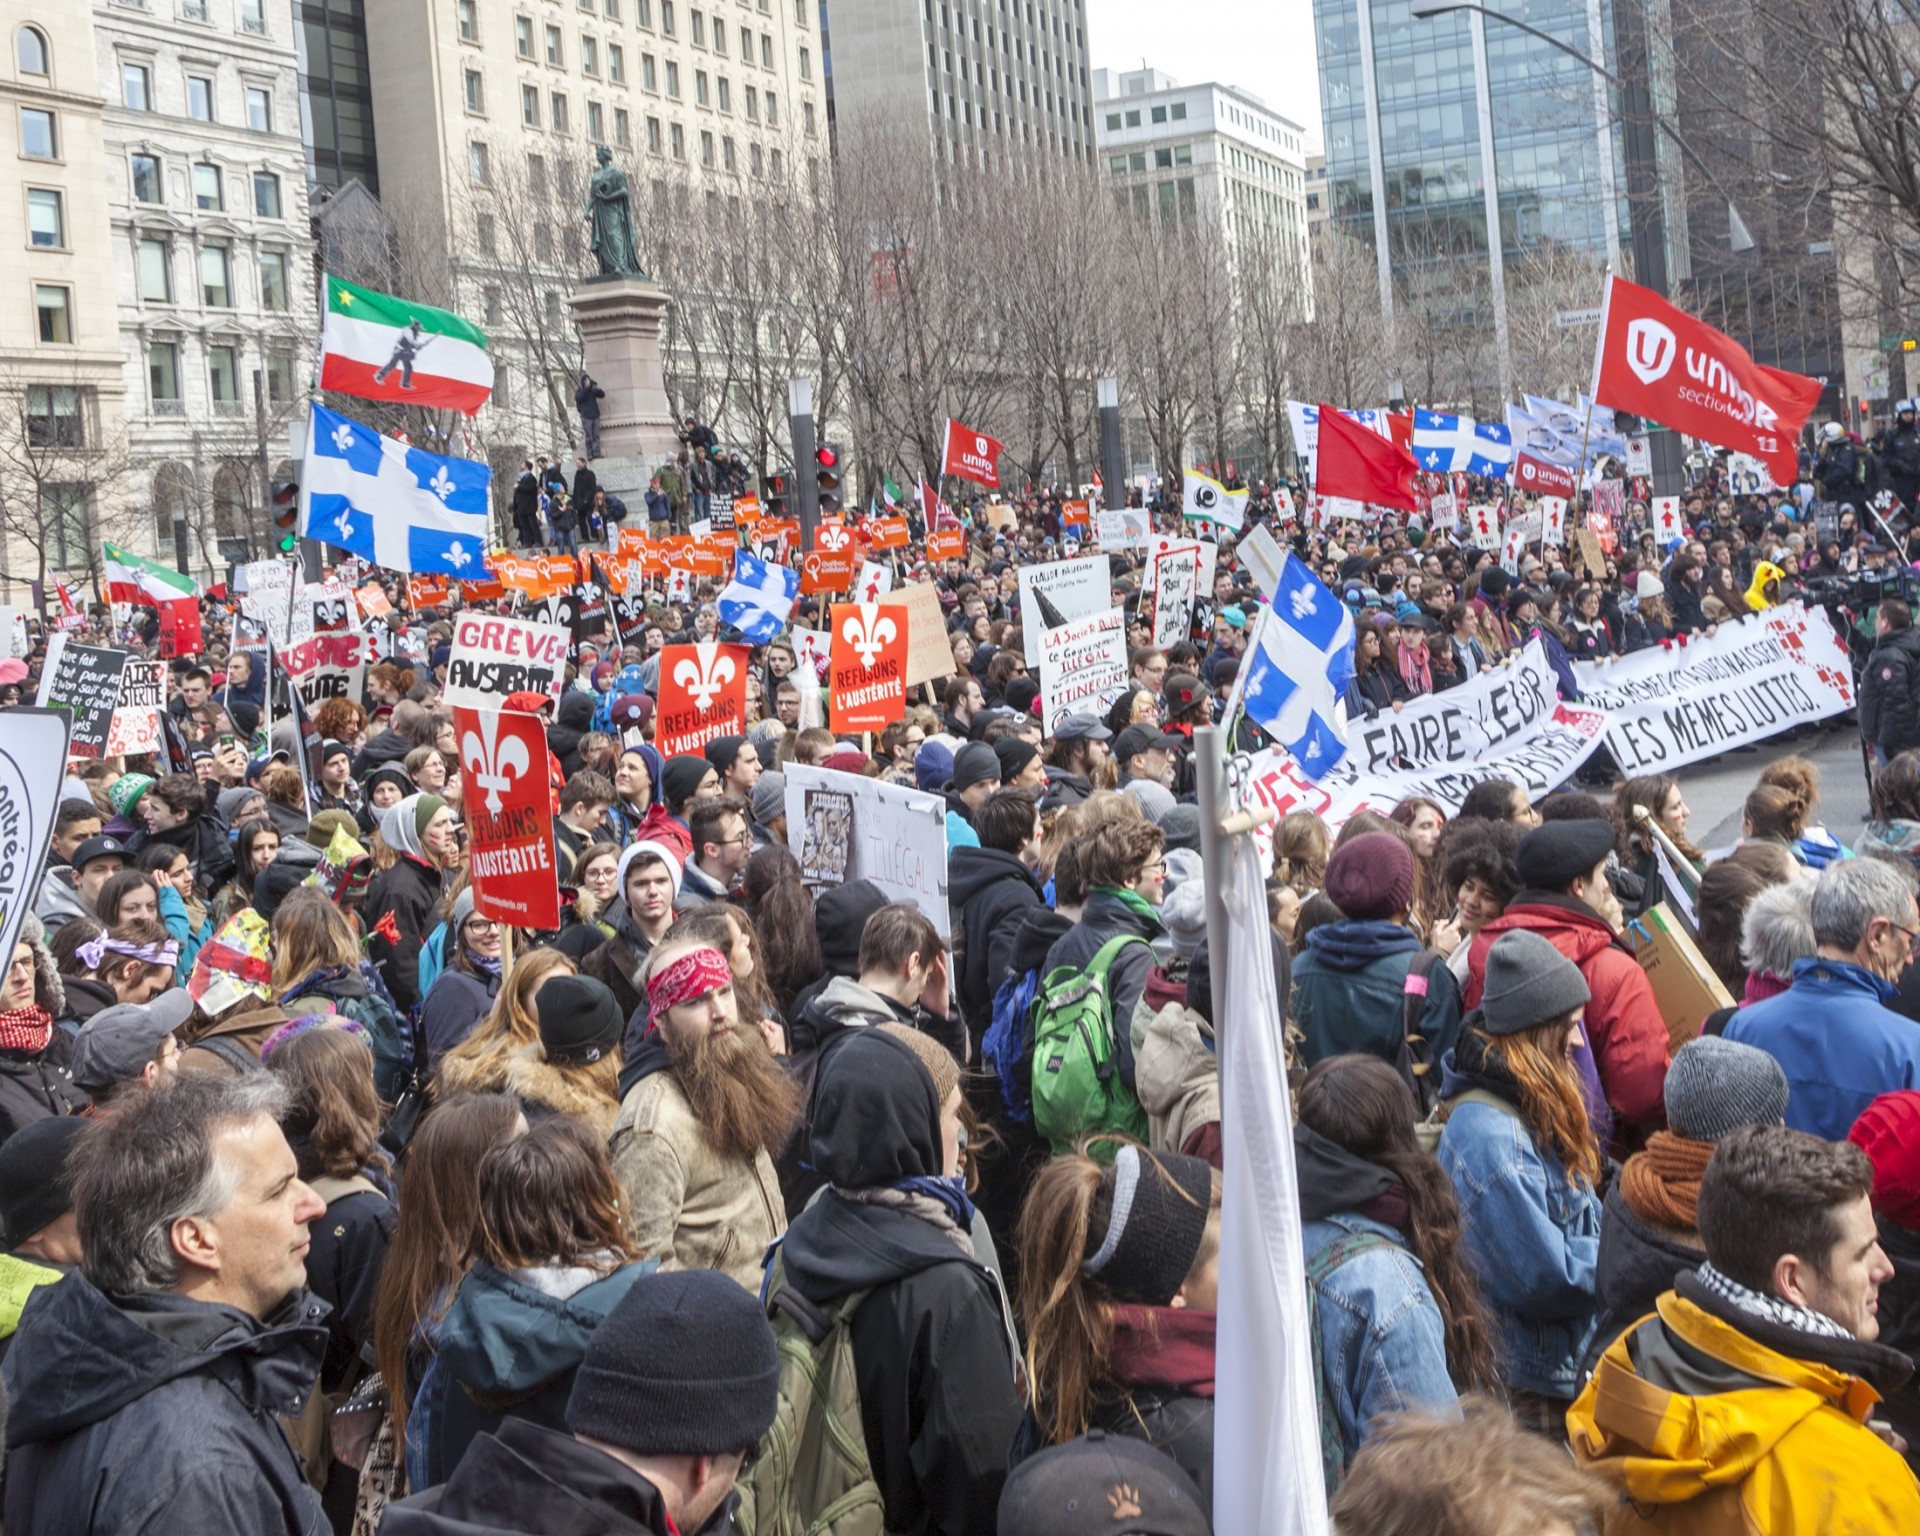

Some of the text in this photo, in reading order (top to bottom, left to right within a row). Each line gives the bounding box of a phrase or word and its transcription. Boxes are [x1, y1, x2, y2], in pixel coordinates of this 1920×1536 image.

[836, 658, 898, 690] REFUSONS
[1721, 637, 1788, 677] NAISSENT
[78, 670, 106, 684] pour
[78, 685, 98, 695] sait
[836, 676, 903, 711] L'AUSTÉRITÉ
[664, 697, 737, 735] REFUSONS
[1605, 716, 1668, 771] LES
[1663, 693, 1748, 754] MÊMES
[1733, 671, 1822, 728] LUTTES.
[663, 715, 740, 757] L'AUSTÉRITÉ
[1363, 708, 1465, 775] FAIRE
[469, 804, 540, 843] EFUSONS
